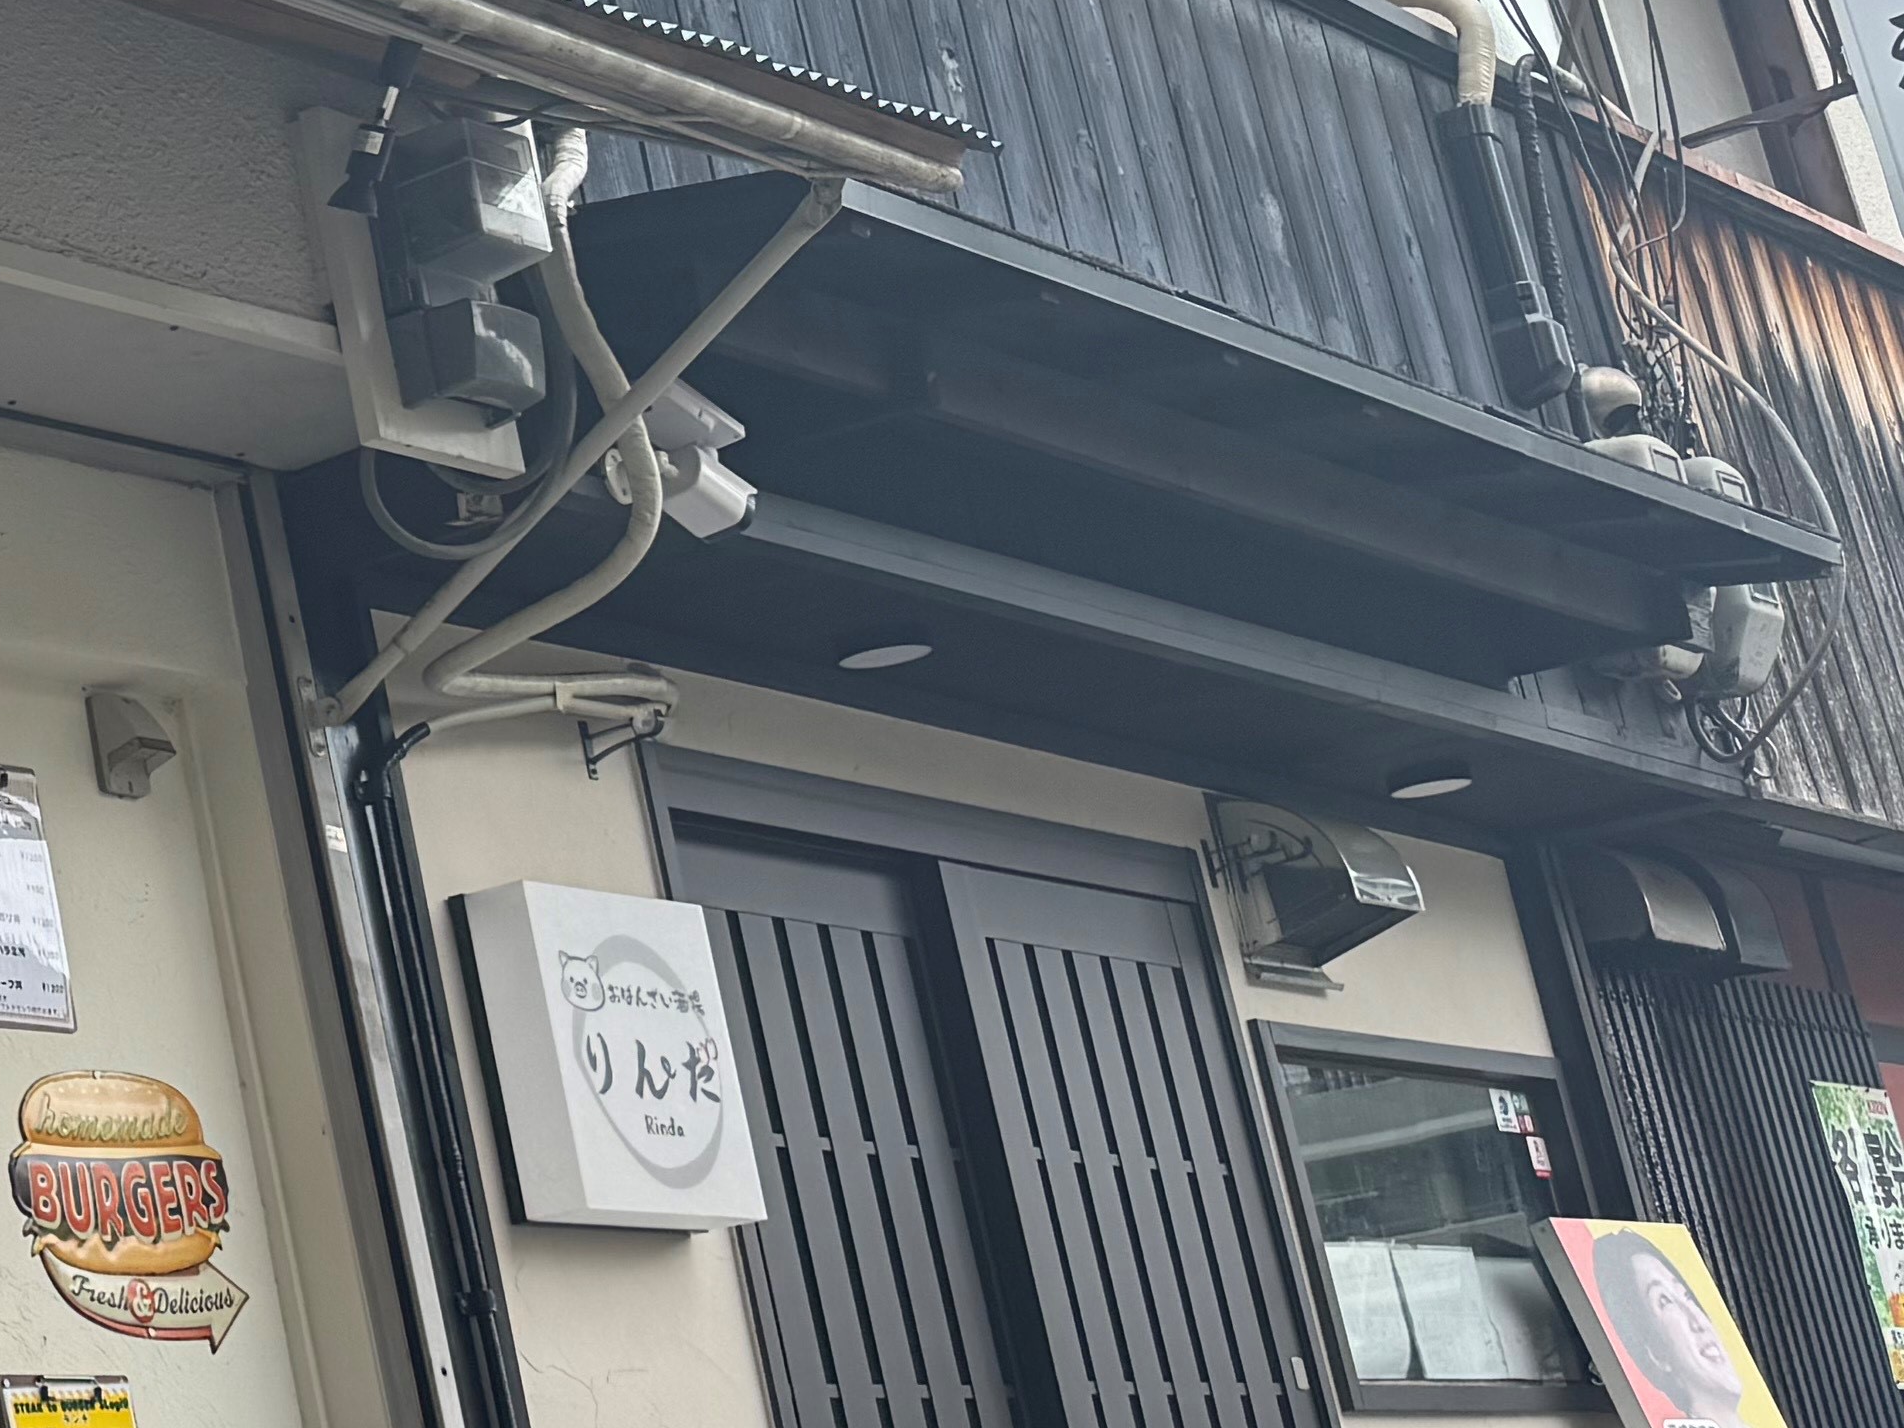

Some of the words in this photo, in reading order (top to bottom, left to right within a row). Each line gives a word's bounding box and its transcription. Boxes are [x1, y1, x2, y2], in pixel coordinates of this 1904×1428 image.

[35, 1092, 189, 1143] homemade
[644, 1114, 686, 1138] Rinda
[27, 1160, 226, 1244] BURGERS
[71, 1274, 129, 1310] Fresh
[154, 1287, 234, 1316] Delicious
